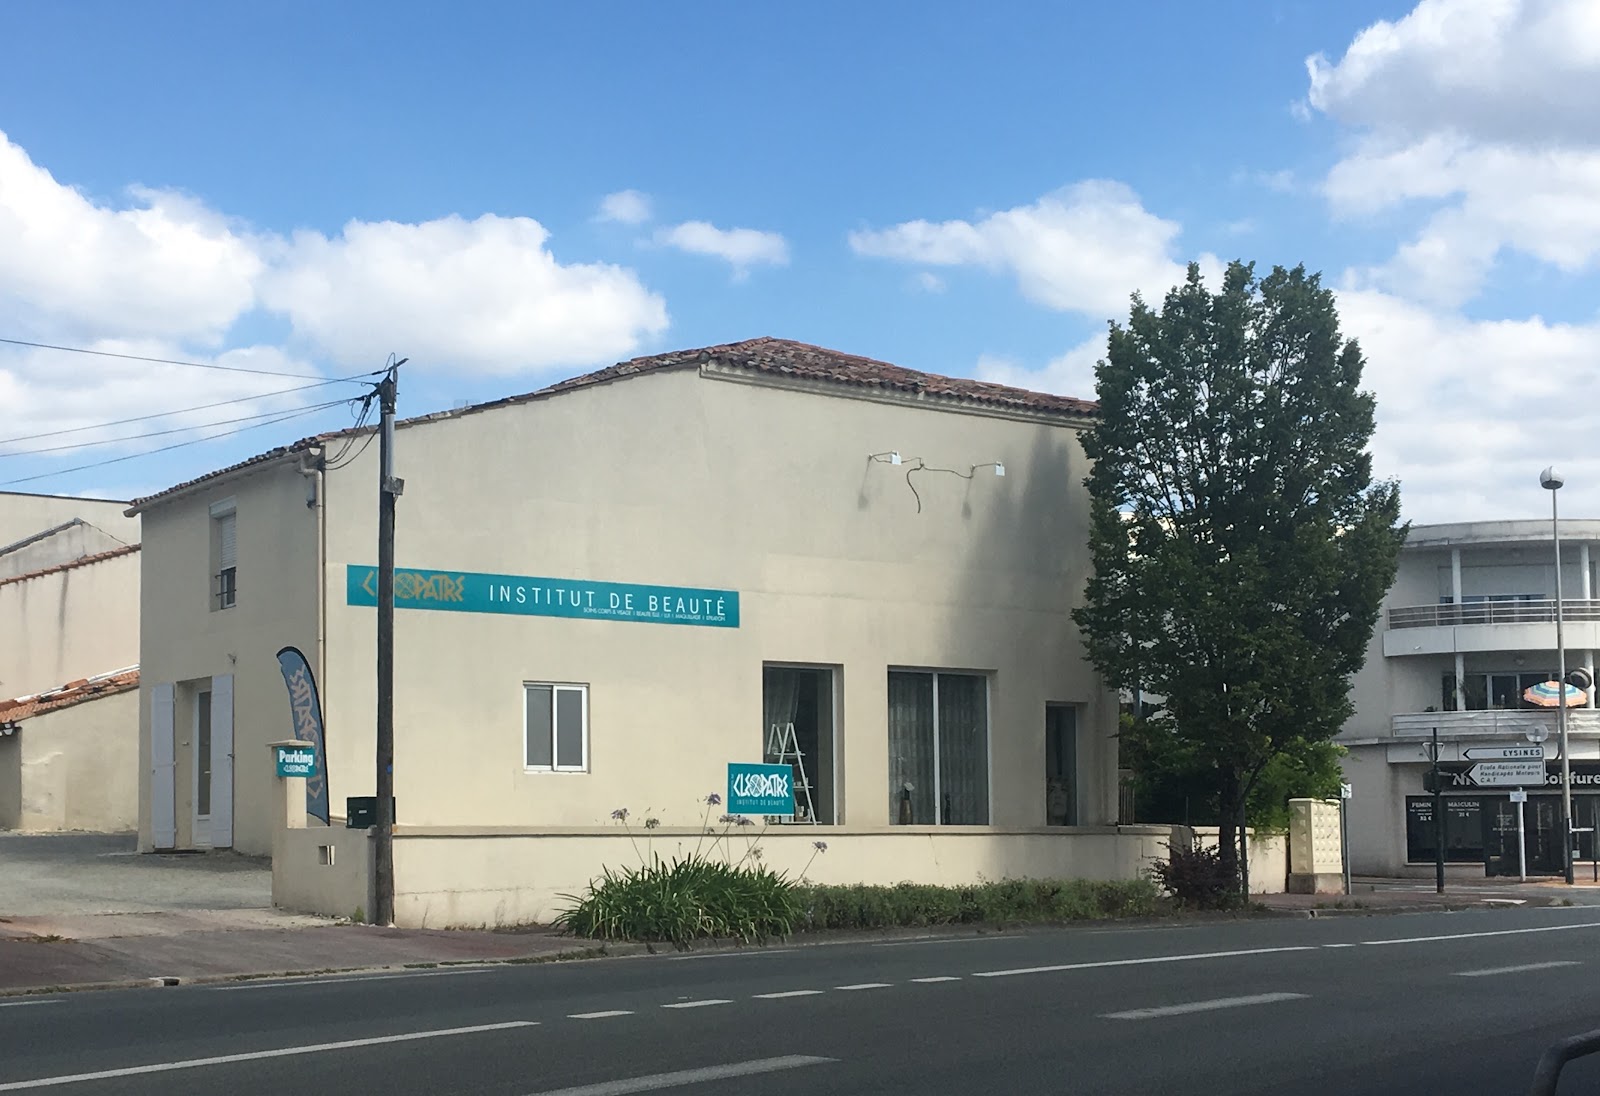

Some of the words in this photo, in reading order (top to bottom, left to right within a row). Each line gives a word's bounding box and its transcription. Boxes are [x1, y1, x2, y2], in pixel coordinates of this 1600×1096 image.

[362, 570, 465, 602] COPATRE
[489, 584, 595, 607] INSTITUT
[609, 592, 634, 610] DE
[649, 595, 726, 616] BEAUTÉ
[279, 750, 314, 766] Parking
[1503, 749, 1541, 757] EYSINES
[733, 773, 789, 798] CLEOPATRE
